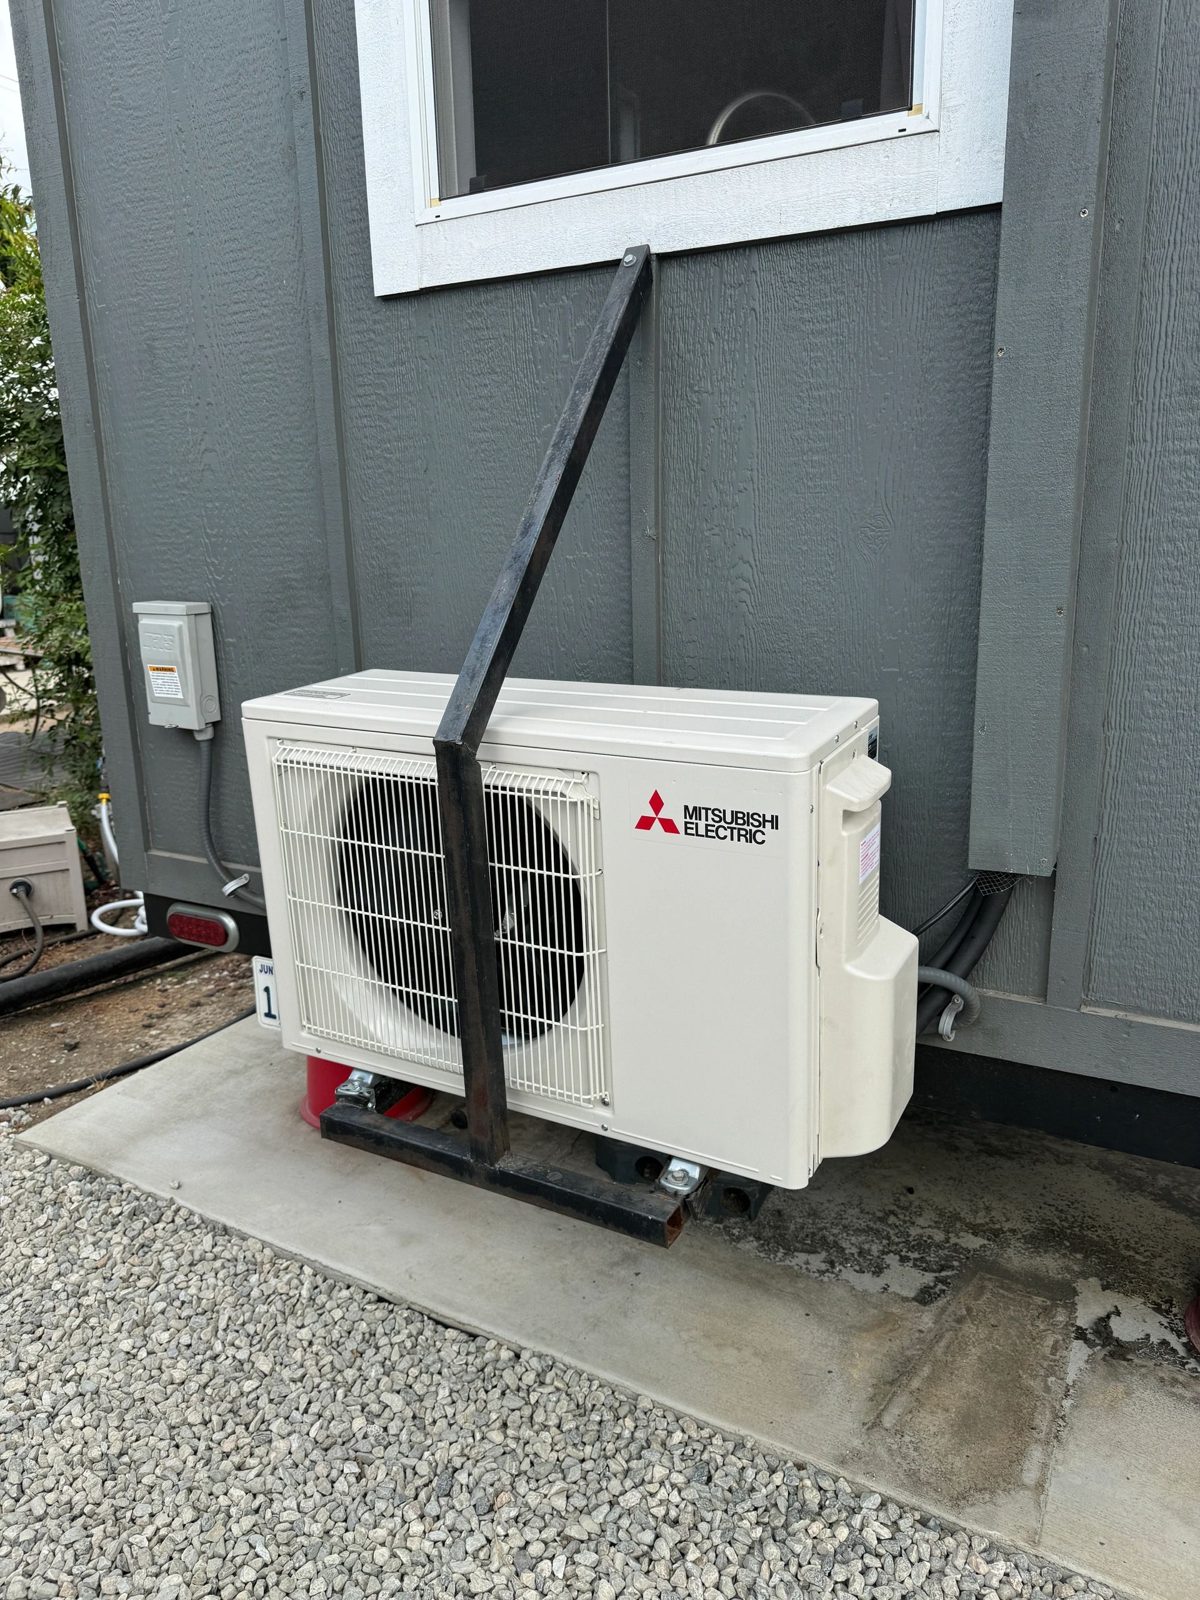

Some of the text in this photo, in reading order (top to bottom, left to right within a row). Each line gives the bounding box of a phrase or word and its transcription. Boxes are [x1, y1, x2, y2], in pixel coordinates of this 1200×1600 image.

[684, 805, 779, 830] MITSUBISHI
[684, 821, 766, 845] ELECTRIC
[259, 964, 274, 975] JUN
[263, 985, 277, 1020] 1
